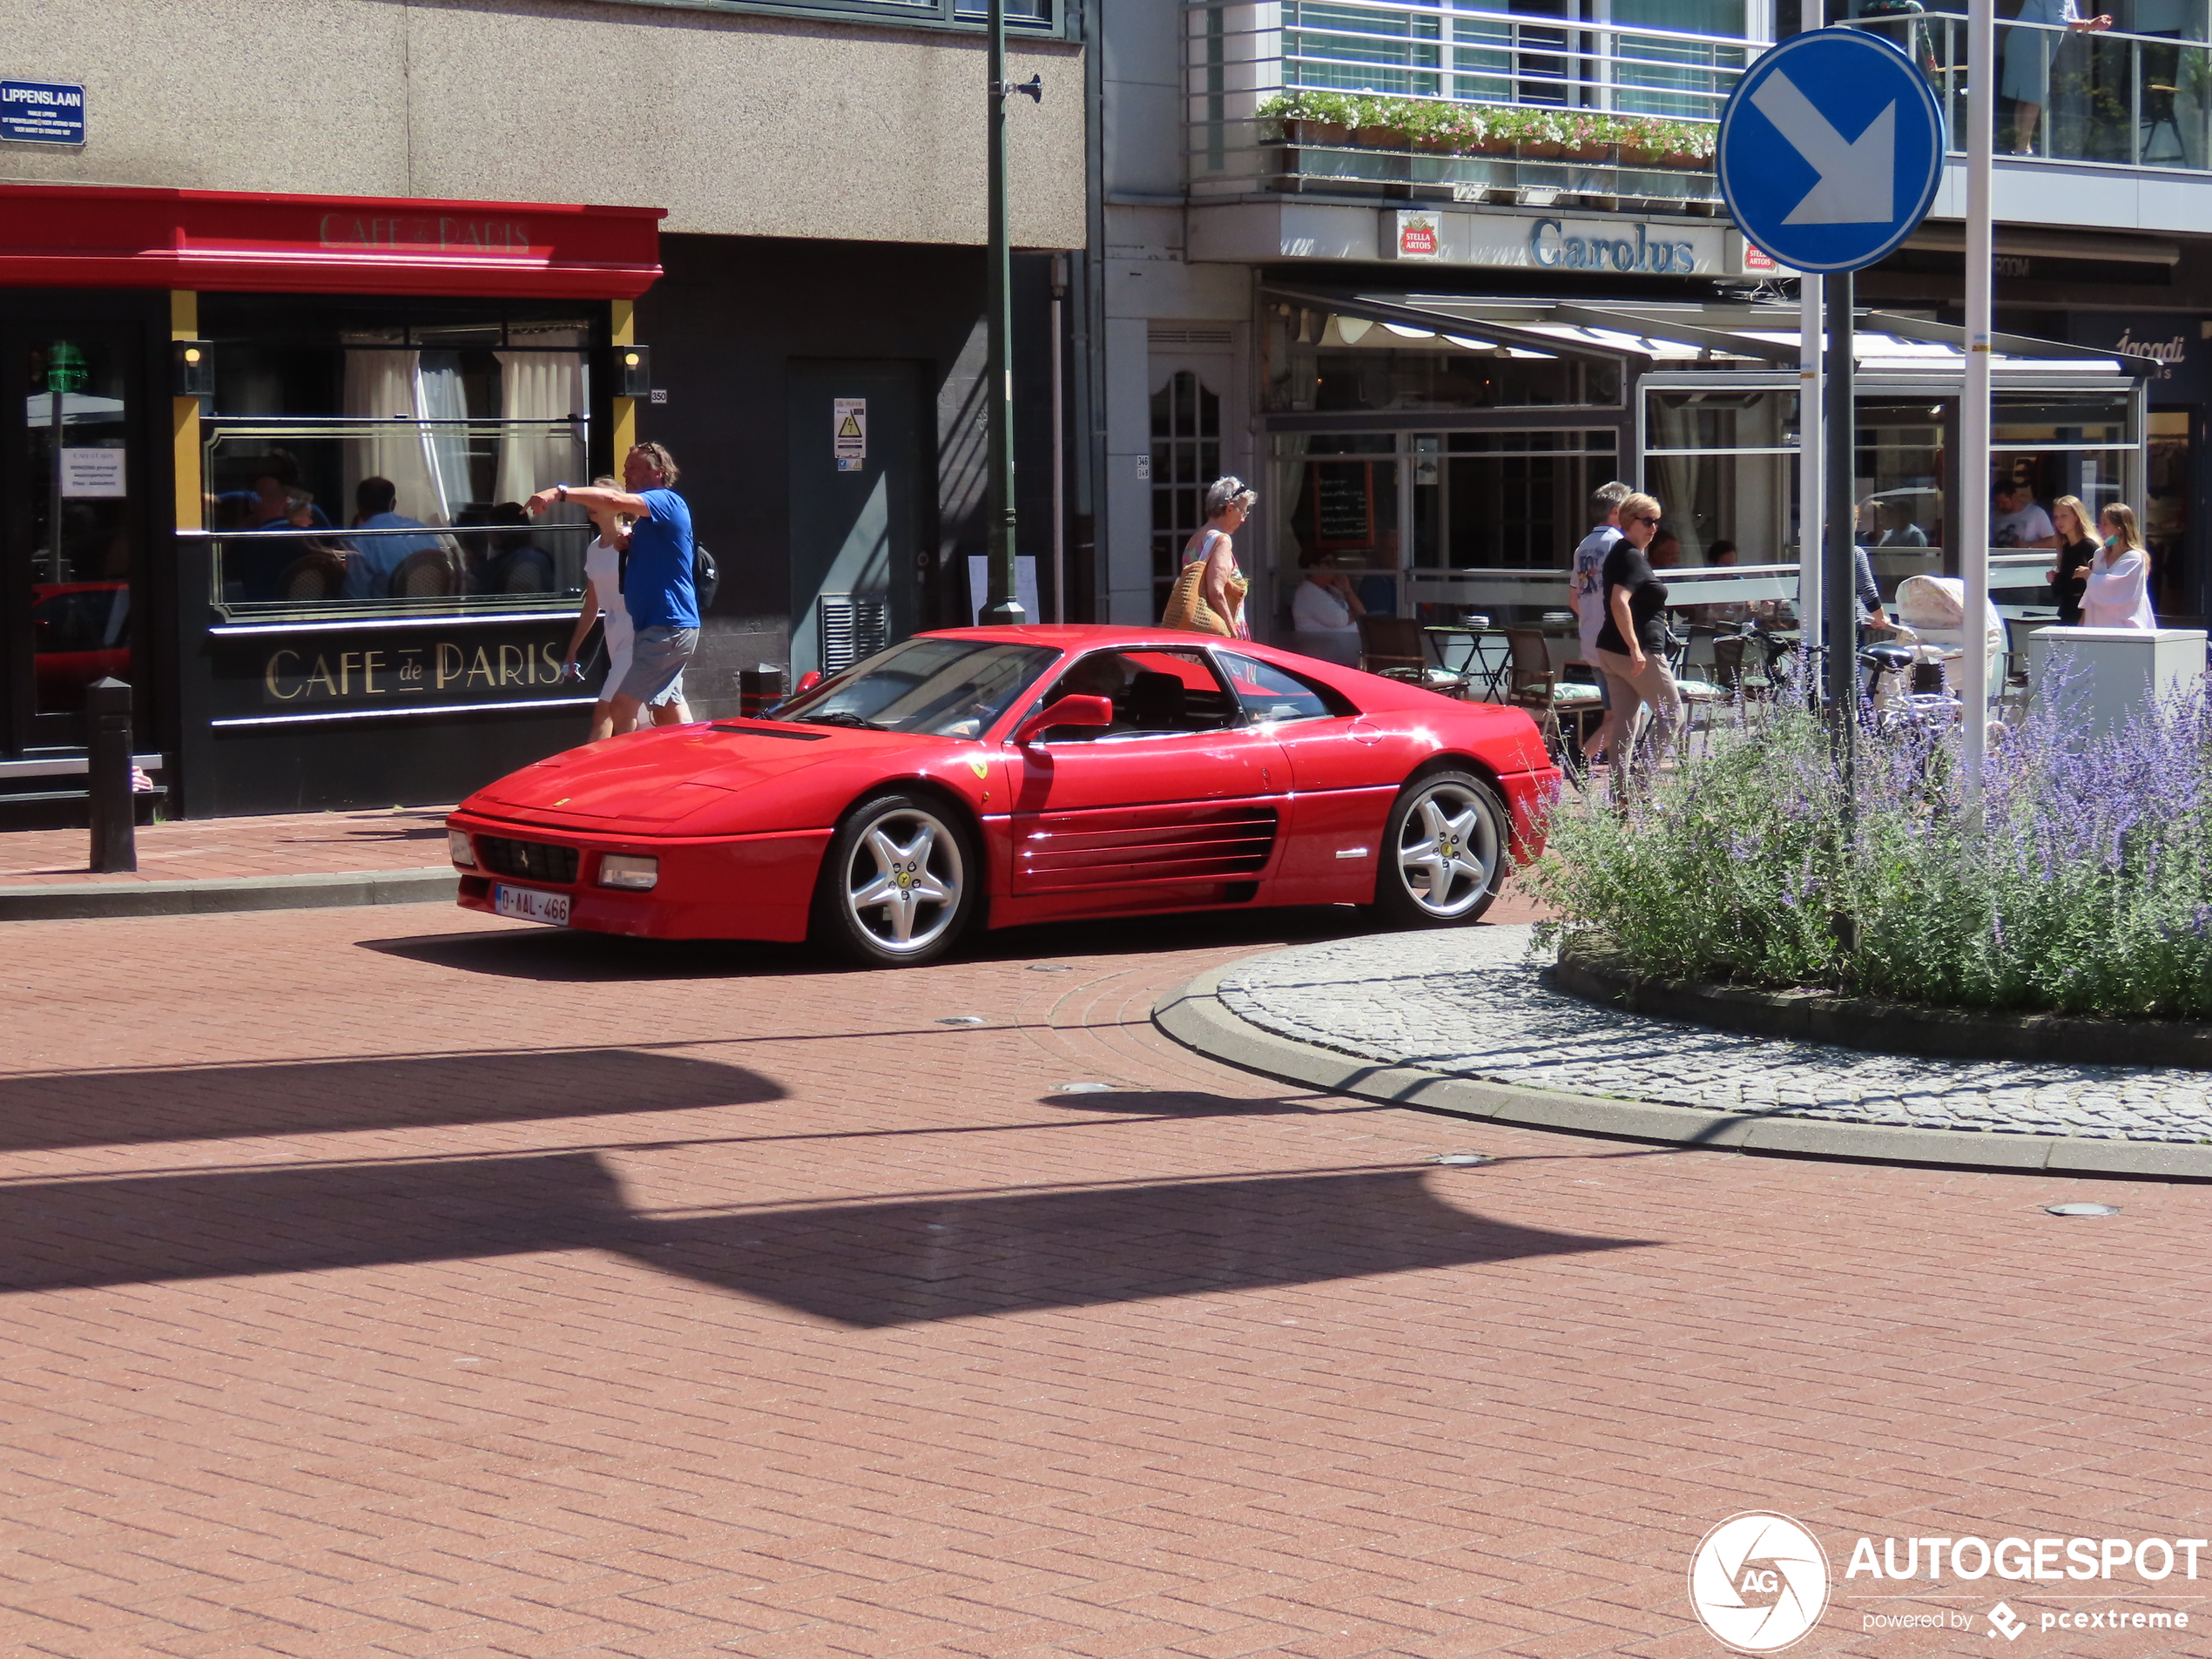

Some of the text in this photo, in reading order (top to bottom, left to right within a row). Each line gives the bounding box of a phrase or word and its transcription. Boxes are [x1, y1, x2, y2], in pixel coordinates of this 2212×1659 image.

[2, 88, 81, 107] LIPPENSLAAN
[439, 218, 529, 254] PARIS
[1406, 233, 1431, 241] STELLA
[1406, 241, 1432, 250] ARTOIS
[1530, 218, 1695, 275] Carolus
[1750, 257, 1771, 266] ARTOIS
[652, 392, 666, 401] 350
[1138, 456, 1149, 466] 346
[266, 642, 568, 700] CAFE de PARIS
